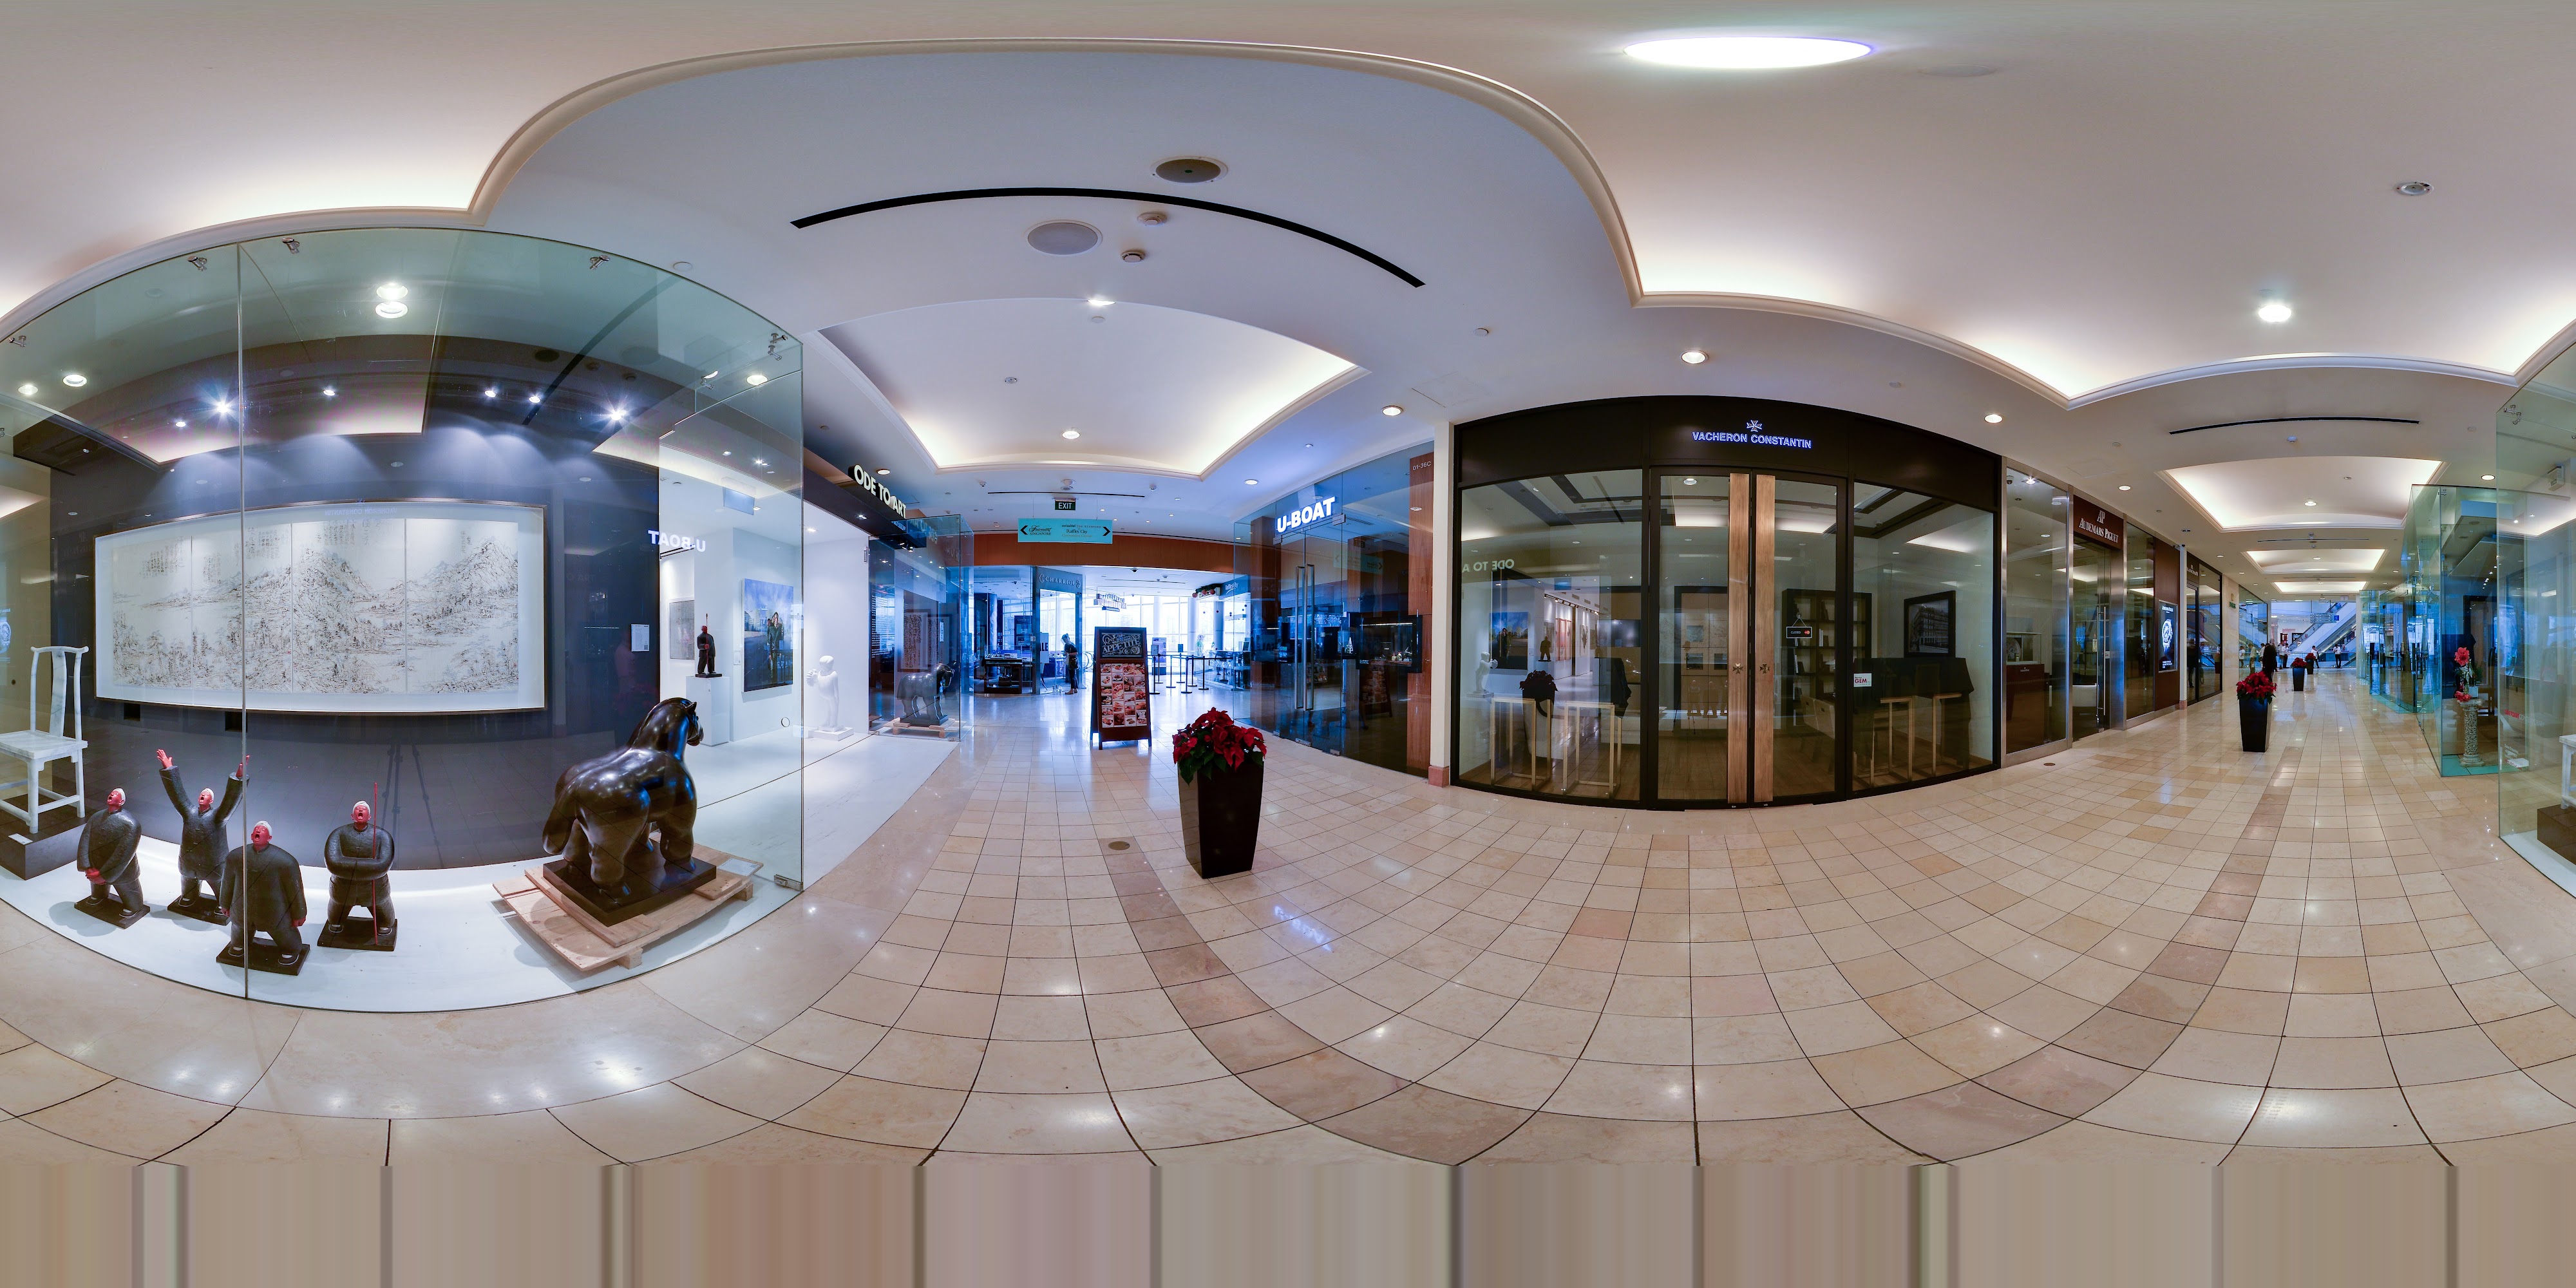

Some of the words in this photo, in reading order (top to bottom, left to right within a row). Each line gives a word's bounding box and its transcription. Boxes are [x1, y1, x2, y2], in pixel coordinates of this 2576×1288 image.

[1692, 431, 1748, 442] VACHERON
[1750, 435, 1812, 448] CONSTANTIN
[1412, 461, 1431, 470] 01-36C
[854, 464, 876, 496] ODE
[878, 482, 891, 506] TO
[893, 496, 907, 519] ART
[1277, 497, 1336, 533] U-BOAT
[2079, 518, 2104, 537] AUDEMARS
[2104, 528, 2119, 543] PIGUET
[1045, 576, 1075, 586] CHARRIOL
